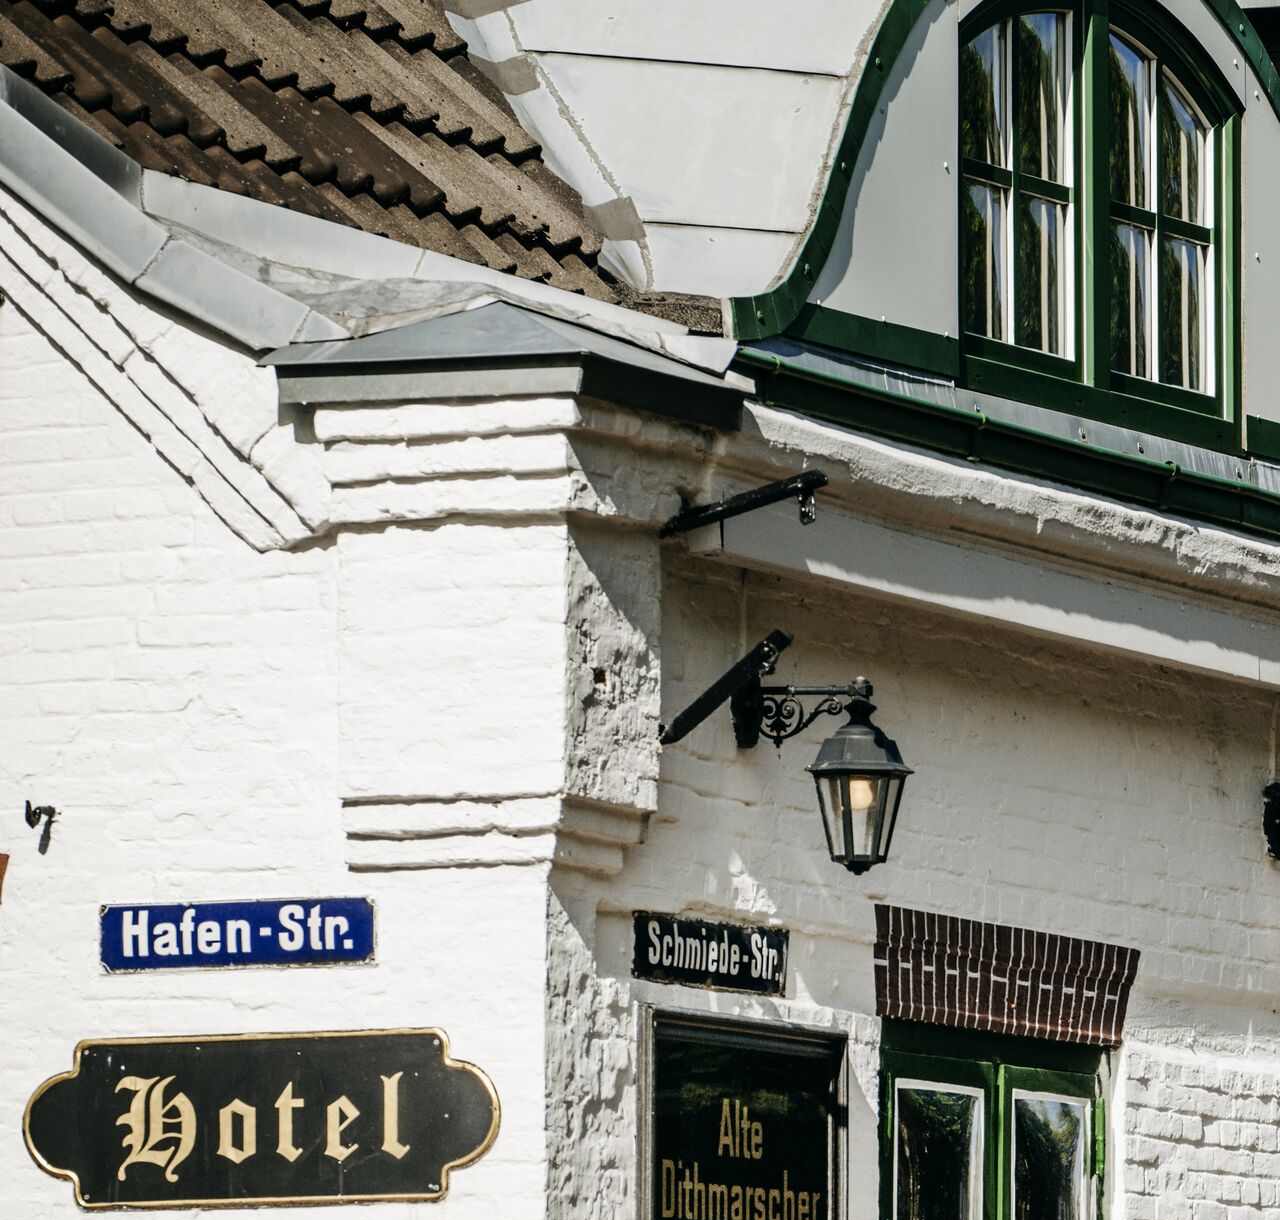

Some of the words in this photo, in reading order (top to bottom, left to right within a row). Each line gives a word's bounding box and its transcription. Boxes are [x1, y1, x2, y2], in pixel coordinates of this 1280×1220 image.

[121, 904, 354, 957] Hafen-Str.
[648, 920, 779, 981] Schmiede-Str.
[114, 1071, 411, 1183] Hotel
[718, 1098, 763, 1160] Alte
